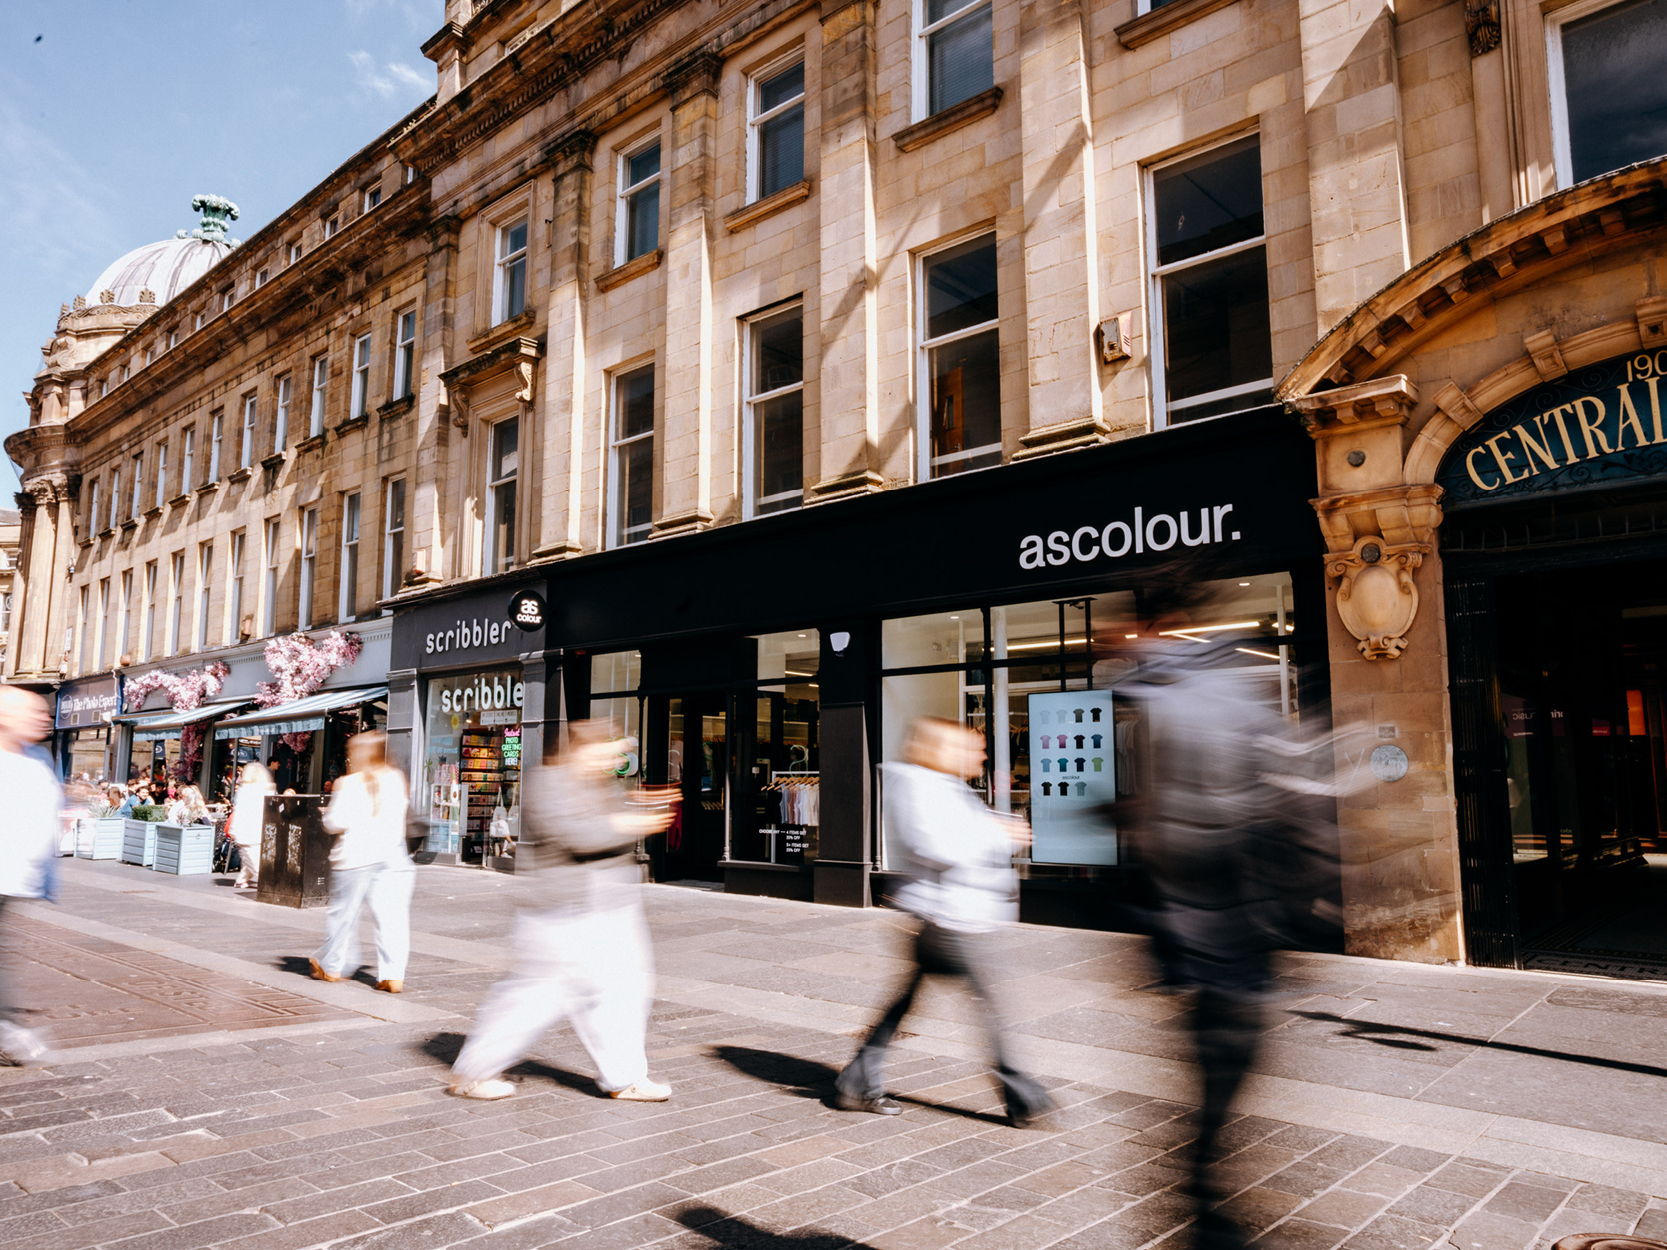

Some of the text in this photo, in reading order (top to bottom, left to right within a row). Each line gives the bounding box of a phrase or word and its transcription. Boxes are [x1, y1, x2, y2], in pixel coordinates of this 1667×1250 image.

[1466, 376, 1667, 491] CENTRAL
[1018, 503, 1241, 570] ascolour.
[425, 618, 511, 654] scribbler
[516, 613, 542, 624] colour
[442, 675, 523, 712] scribble
